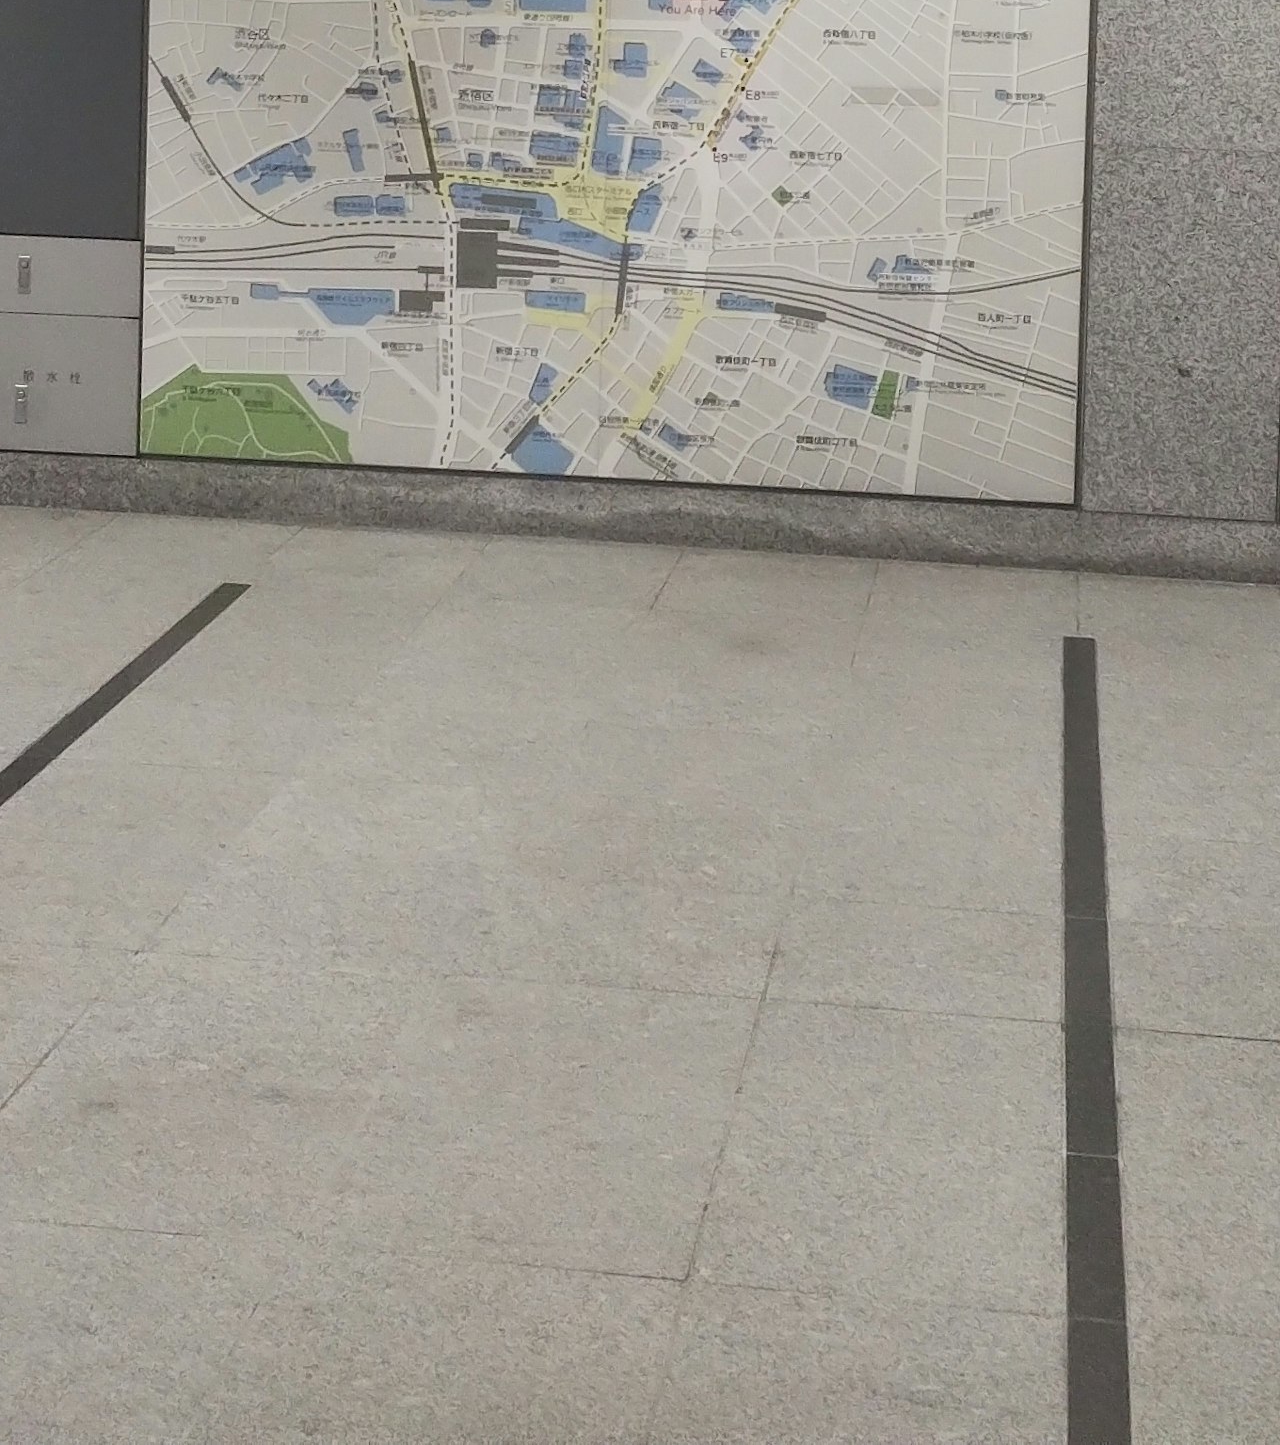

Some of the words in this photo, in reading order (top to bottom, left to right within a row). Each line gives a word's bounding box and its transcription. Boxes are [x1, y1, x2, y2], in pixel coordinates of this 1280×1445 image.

[659, 4, 681, 15] You
[684, 5, 705, 16] Are
[708, 6, 737, 17] Here
[721, 47, 734, 58] E7
[458, 89, 495, 102] 新宿区
[745, 90, 761, 101] E8
[713, 153, 728, 163] E9
